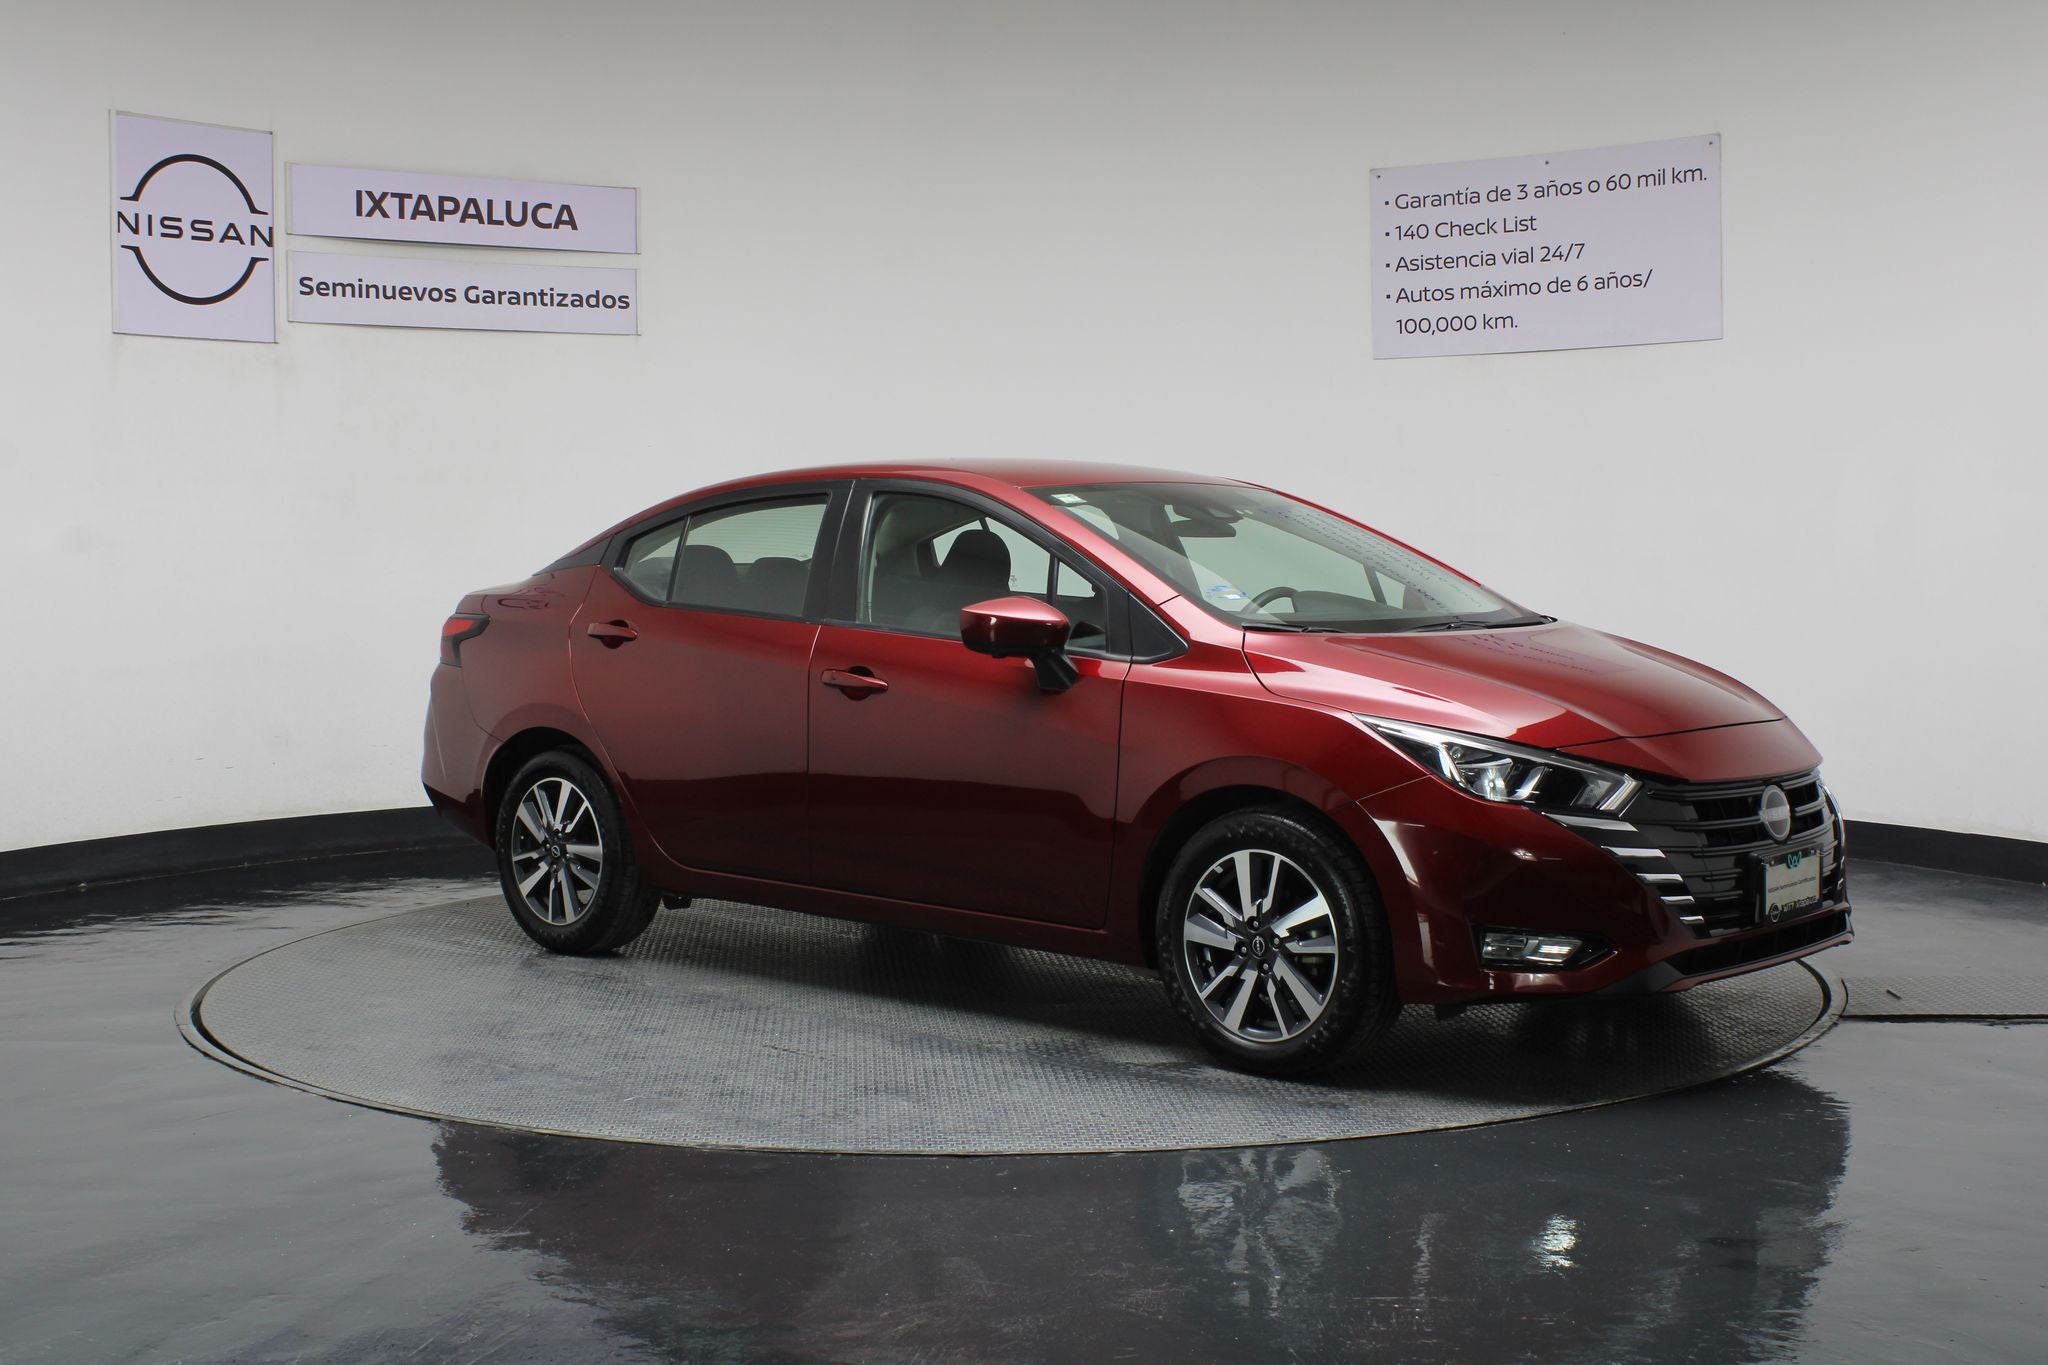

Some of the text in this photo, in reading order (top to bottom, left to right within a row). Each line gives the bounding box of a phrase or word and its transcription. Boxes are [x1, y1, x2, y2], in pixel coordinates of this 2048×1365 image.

[1394, 166, 1708, 210] Garantía de 3 años o 60 mil km.
[355, 189, 579, 231] IXTAPALUCA
[1394, 214, 1537, 241] 140 Check List
[117, 210, 274, 248] NISSAN
[1395, 242, 1586, 273] Asistencia vial 24/7
[299, 276, 630, 310] Seminuevos Garantizados
[1395, 268, 1653, 304] Autos máximo de 6 años/
[1395, 313, 1519, 336] 100,000 km.
